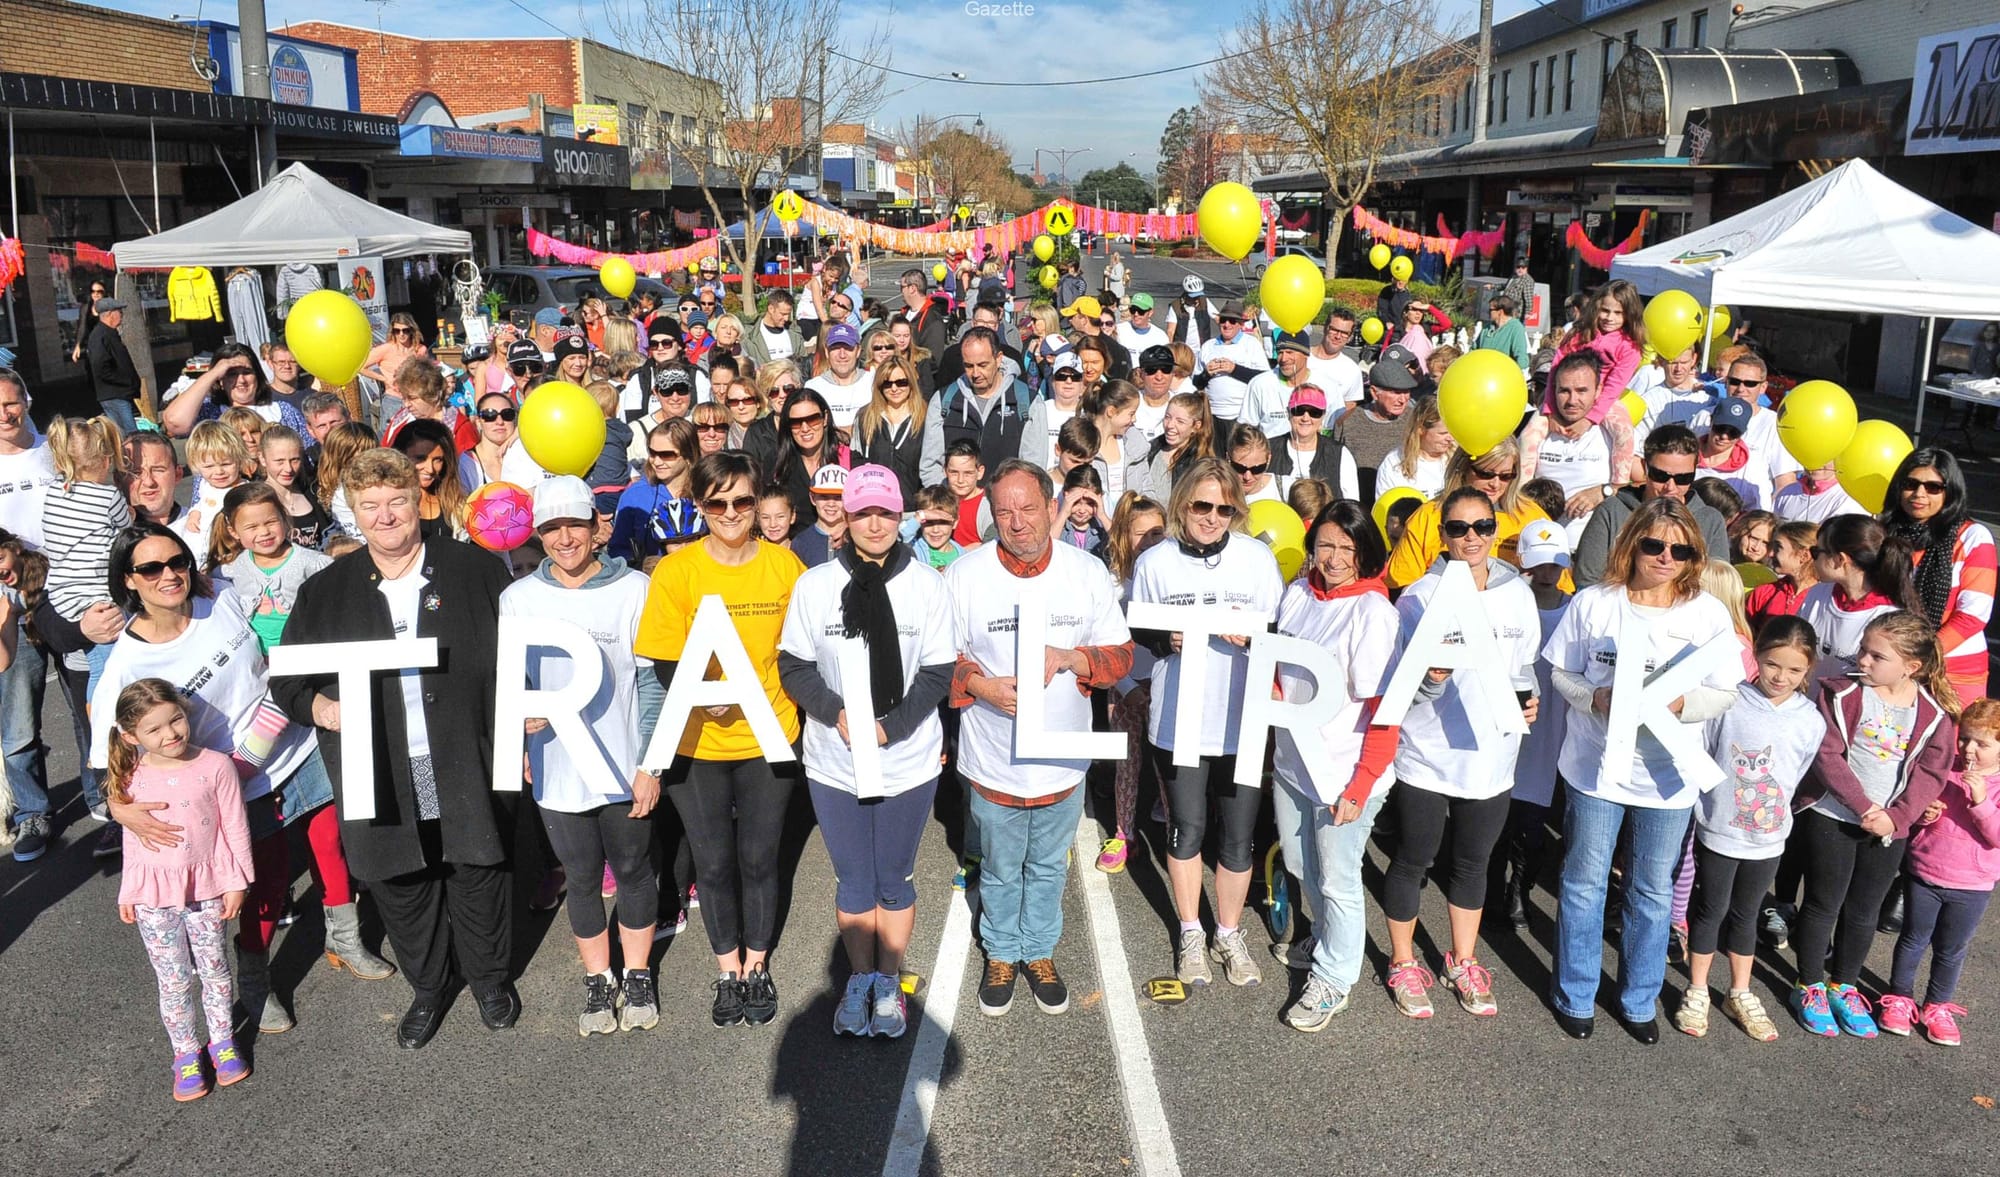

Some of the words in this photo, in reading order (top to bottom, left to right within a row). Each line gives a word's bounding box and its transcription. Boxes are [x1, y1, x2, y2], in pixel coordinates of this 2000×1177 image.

[274, 67, 309, 86] DINKUM
[272, 110, 337, 131] SHOWCASE
[342, 119, 398, 137] JEWELLERS
[1723, 111, 1778, 138] VIVA
[1794, 95, 1898, 132] LATTE
[443, 130, 488, 154] DINKUM
[490, 135, 543, 159] DISCOUNTS
[553, 148, 616, 177] SHOOZONE
